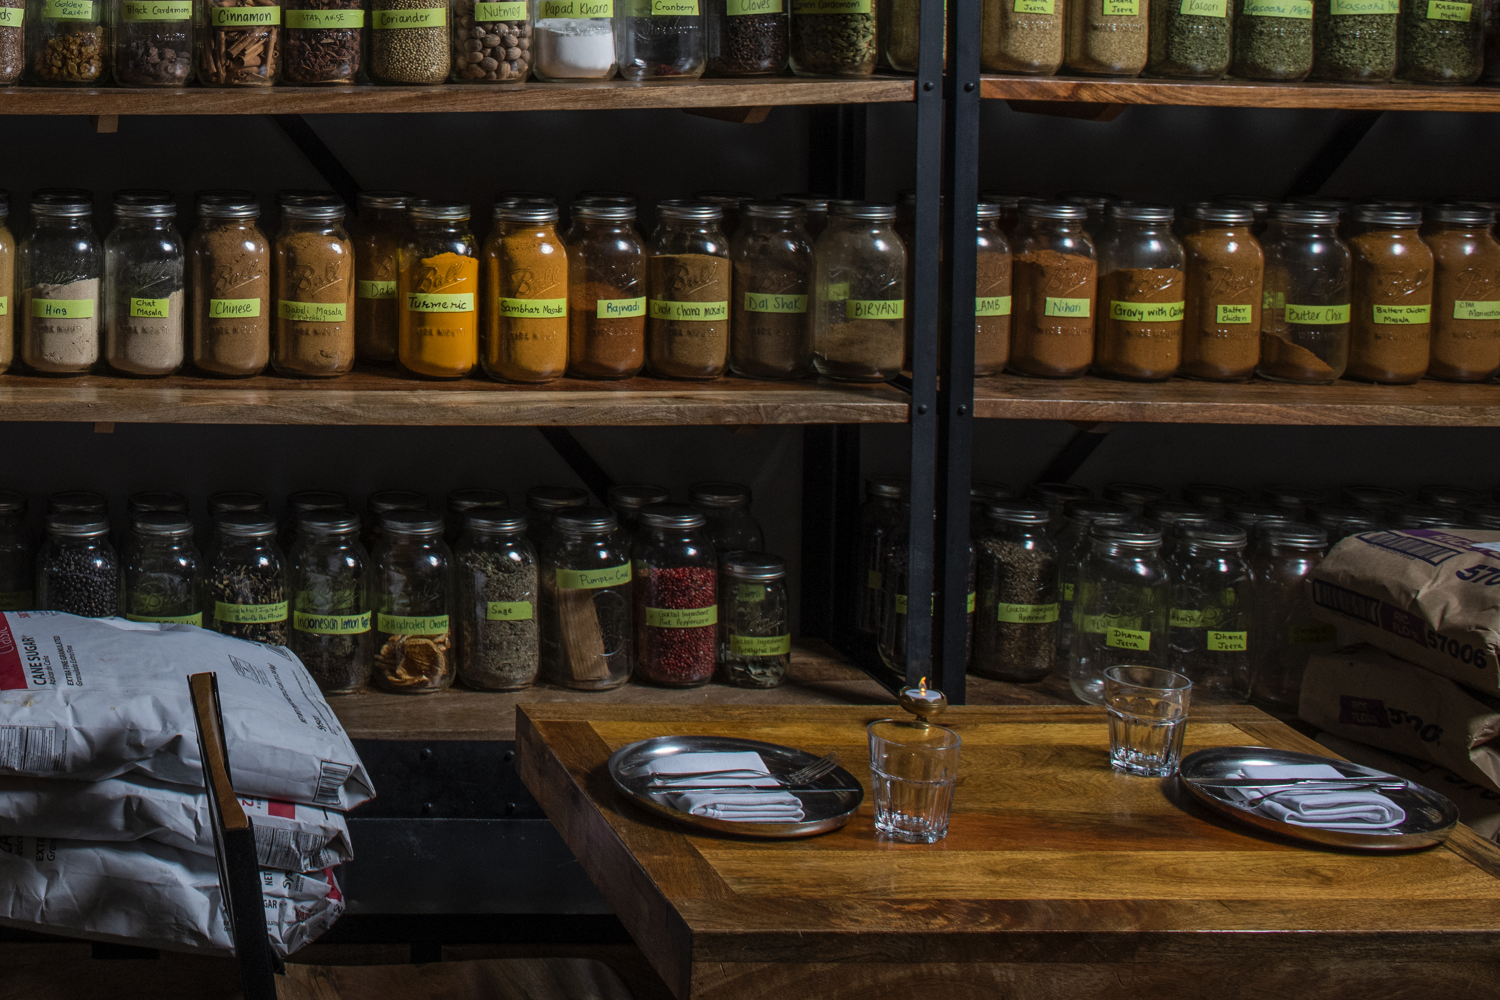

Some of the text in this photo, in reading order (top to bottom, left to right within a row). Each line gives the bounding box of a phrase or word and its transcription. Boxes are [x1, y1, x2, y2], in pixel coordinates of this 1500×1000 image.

[127, 5, 189, 14] Black Cardamom
[484, 6, 520, 18] Nutmeg
[545, 2, 608, 16] Papad Kharo
[655, 1, 695, 12] Cranberry
[1189, 0, 1218, 11] Kasoori
[1247, 0, 1285, 14] Kasoori
[1336, 0, 1384, 11] Kasoori
[1435, 3, 1465, 11] Kasoori
[218, 10, 272, 23] Cinnamon
[302, 15, 321, 24] STAR
[381, 13, 430, 25] Coriander
[46, 304, 67, 315] Hing
[215, 301, 252, 315] Chinese
[409, 297, 466, 310] Turmeric
[501, 300, 540, 313] Sambhar
[607, 301, 640, 315] Rajwadi
[653, 303, 671, 315] Chole
[749, 296, 801, 310] Dal Shak
[855, 303, 898, 316] BIRYANI
[1054, 299, 1081, 315] Nihari
[136, 308, 162, 316] Masala
[316, 306, 343, 316] Masala
[1115, 304, 1166, 321] Gravy with
[1289, 307, 1321, 321] Butter
[492, 605, 512, 615] Sage
[297, 617, 338, 630] Indonesian
[341, 618, 359, 629] Lemon
[1114, 630, 1144, 640] Dhana
[1116, 639, 1139, 648] Jeera
[1426, 630, 1488, 671] 57006
[22, 635, 47, 686] CANE SUGAR
[264, 872, 274, 887] NET
